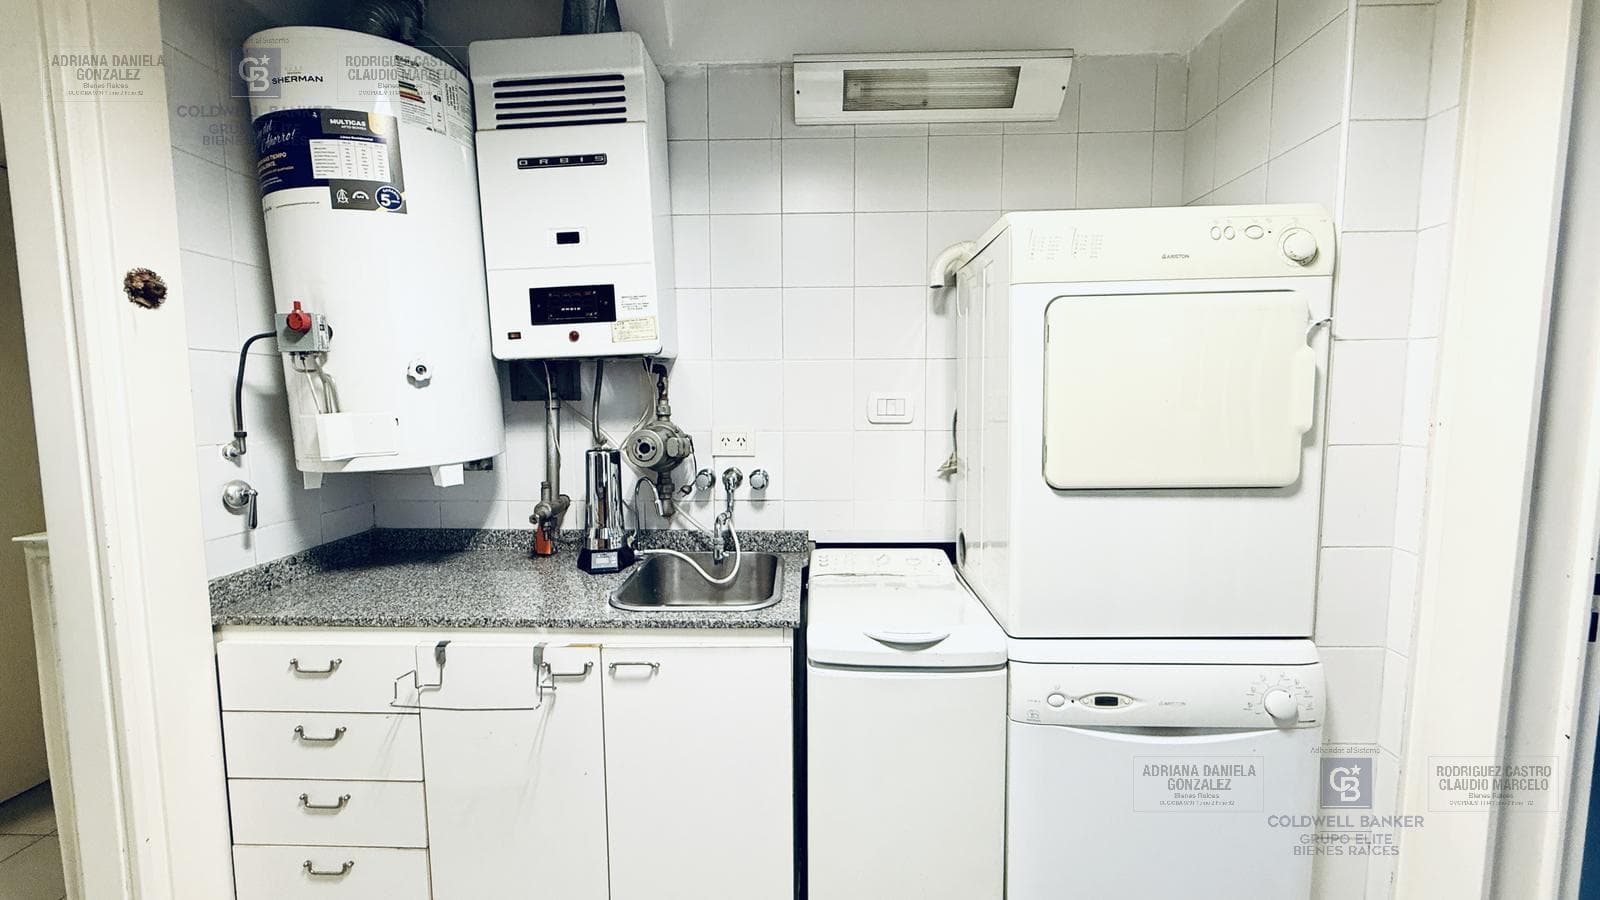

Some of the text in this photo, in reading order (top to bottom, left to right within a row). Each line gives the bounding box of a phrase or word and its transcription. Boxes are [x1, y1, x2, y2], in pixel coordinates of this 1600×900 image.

[272, 75, 323, 85] SHERMAN
[329, 118, 367, 127] MULTIGAS
[518, 155, 605, 167] ORBIS
[380, 193, 391, 206] 5
